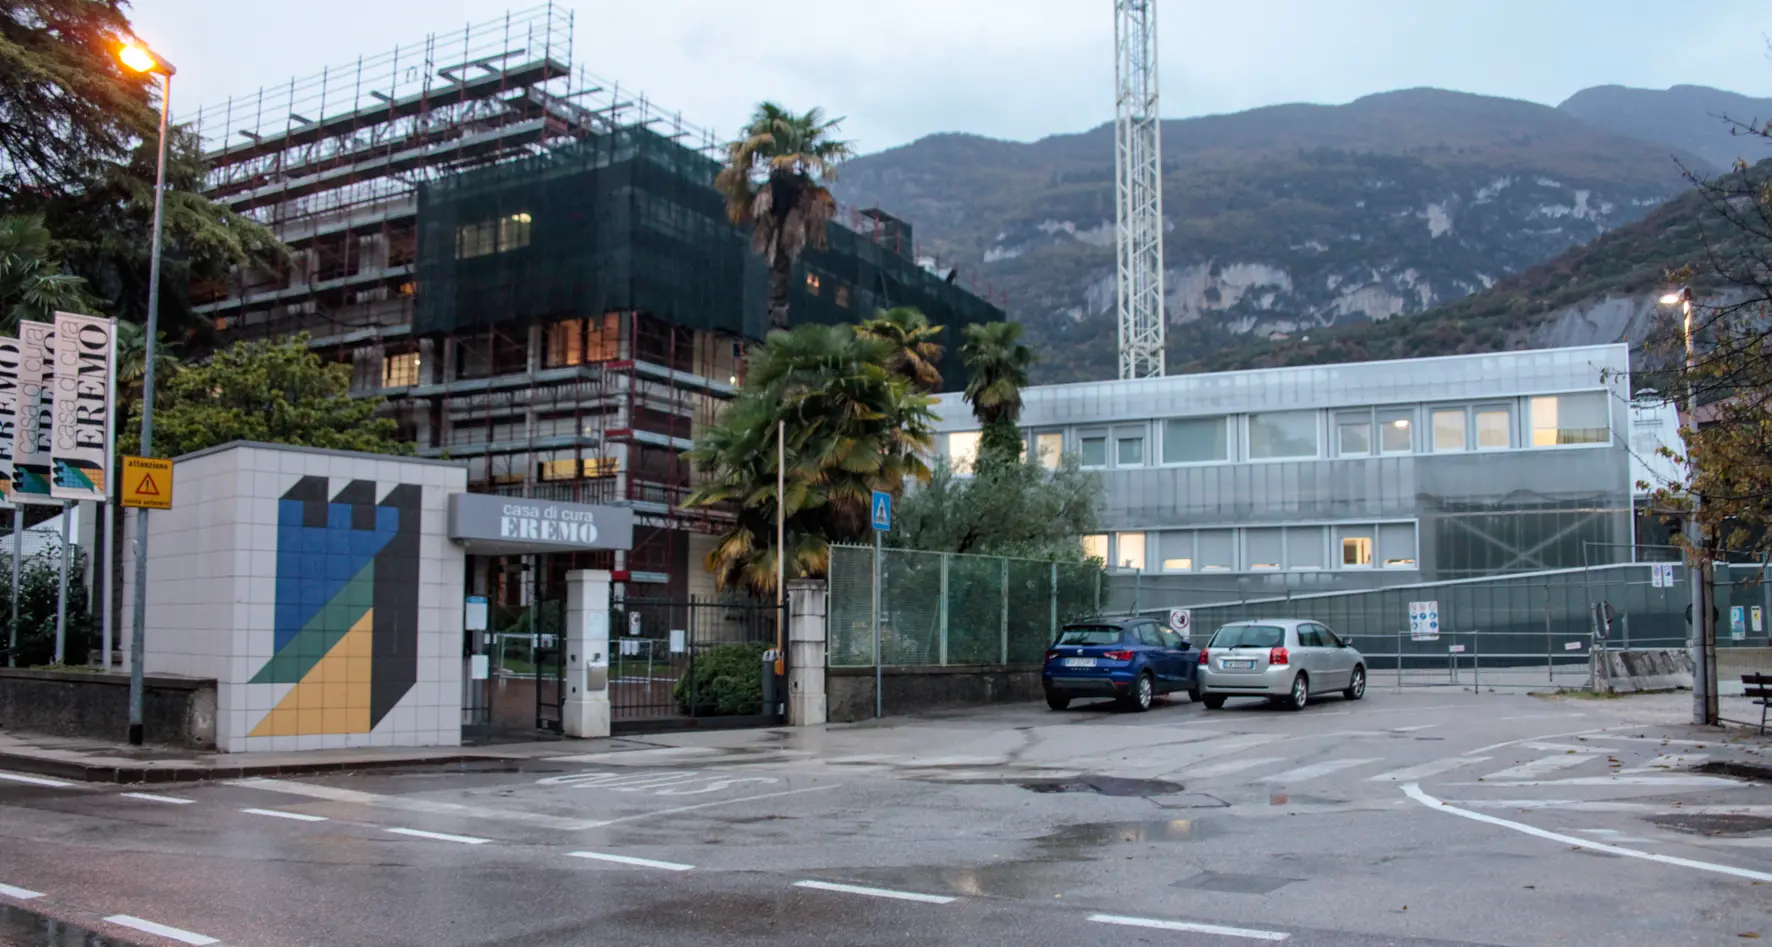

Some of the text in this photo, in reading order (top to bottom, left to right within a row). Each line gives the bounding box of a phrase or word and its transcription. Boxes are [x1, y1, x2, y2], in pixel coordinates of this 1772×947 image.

[18, 328, 44, 454] casa di cura
[55, 321, 79, 450] casa di cura
[76, 324, 108, 452] EREMO
[500, 516, 598, 544] EREMO
[503, 504, 594, 522] casa di cura
